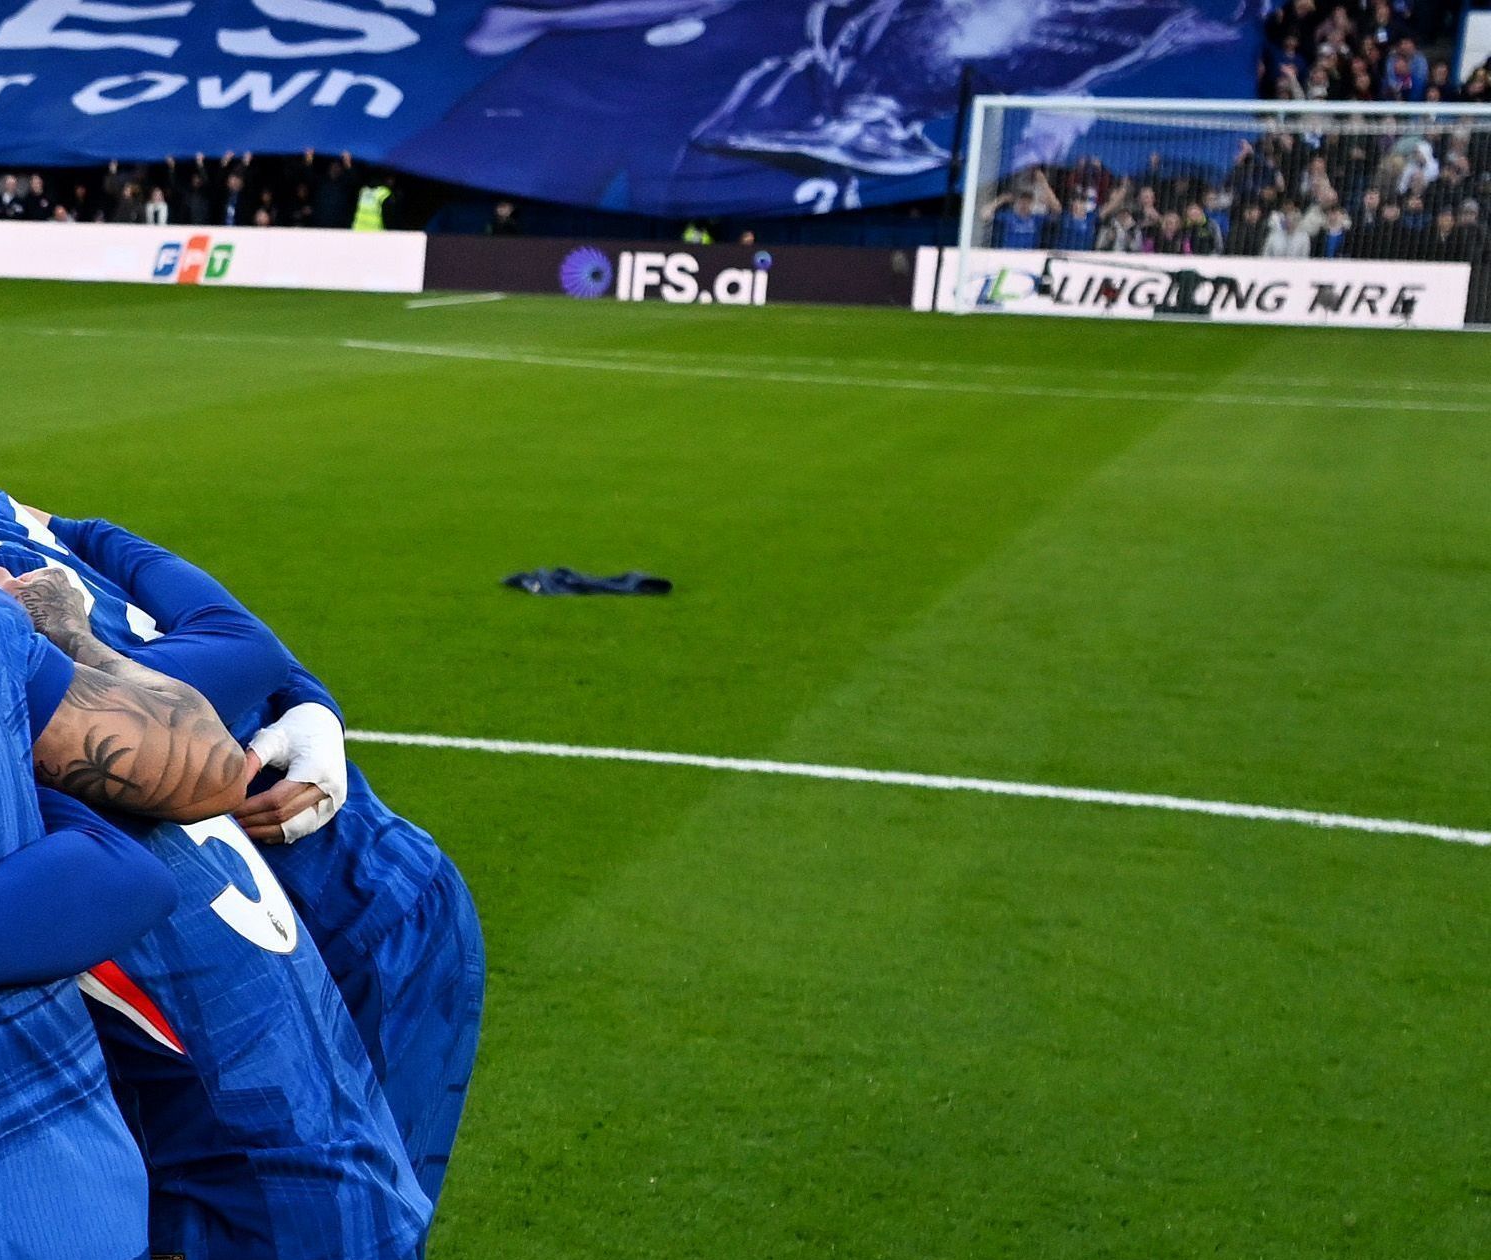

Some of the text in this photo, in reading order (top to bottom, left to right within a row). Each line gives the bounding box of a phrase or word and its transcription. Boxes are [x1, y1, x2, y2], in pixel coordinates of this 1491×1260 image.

[152, 235, 234, 284] FPT
[617, 250, 773, 306] IFS.ai
[1309, 281, 1427, 315] TIRE
